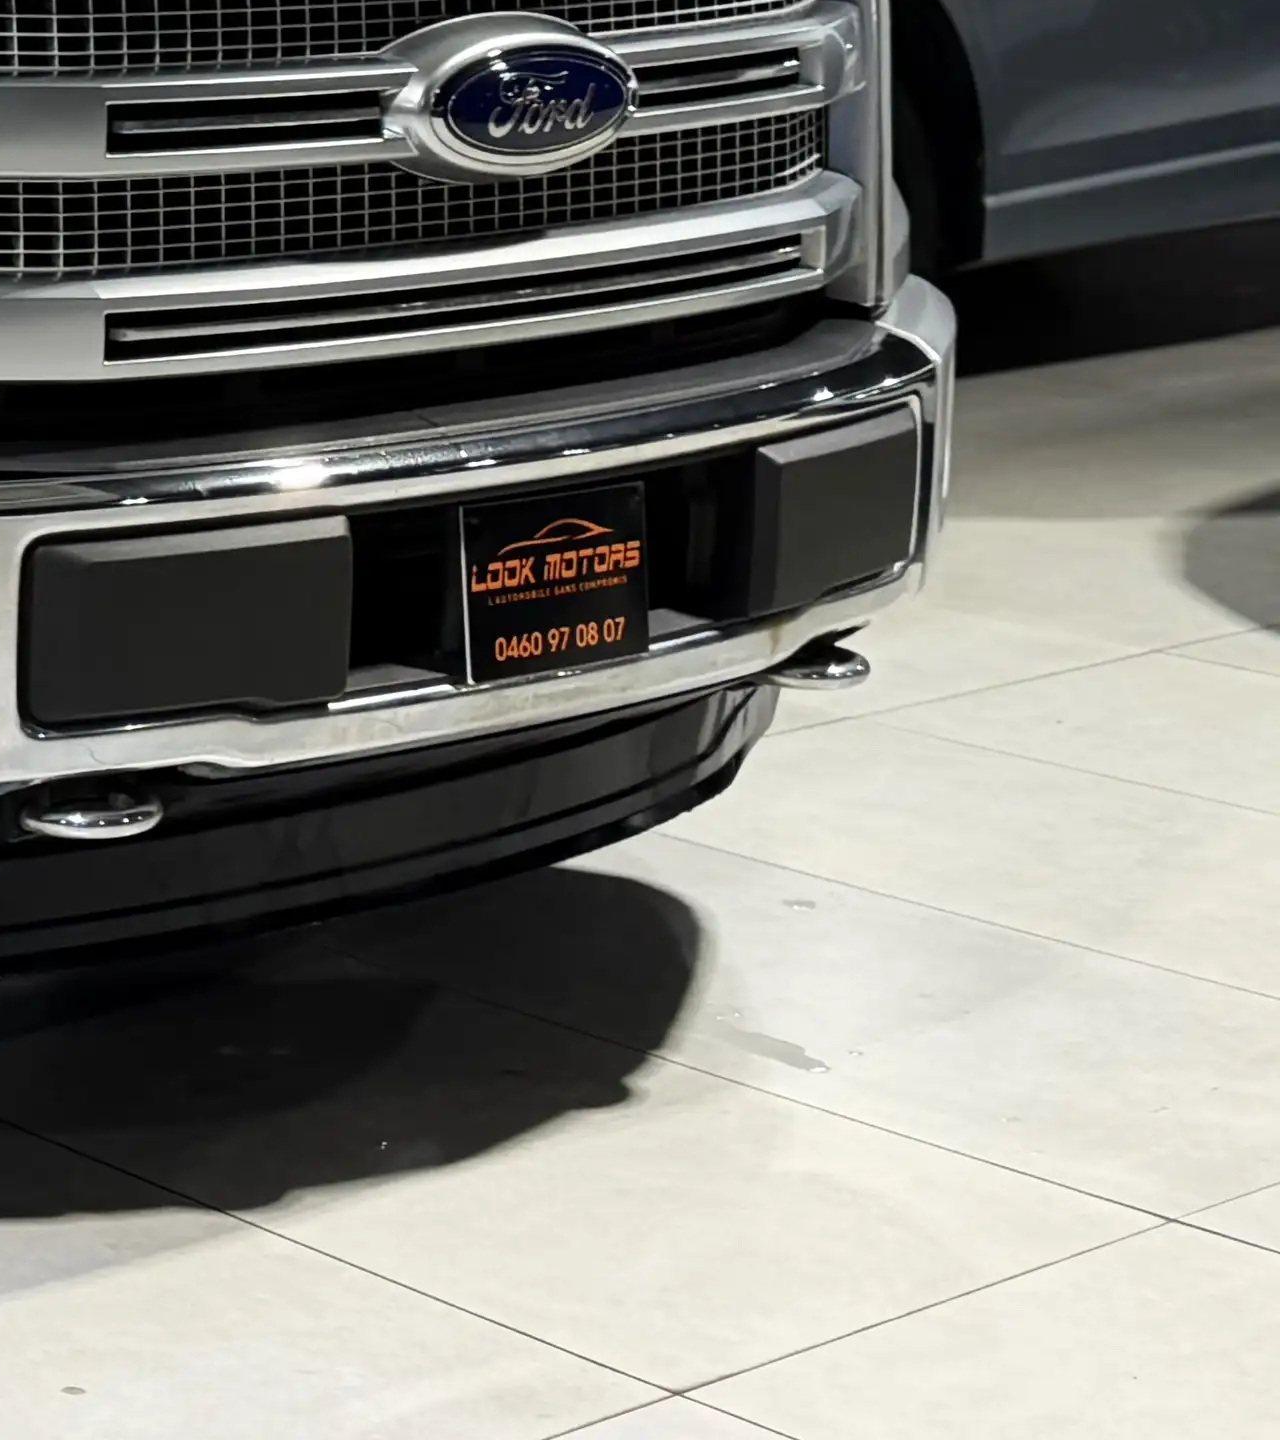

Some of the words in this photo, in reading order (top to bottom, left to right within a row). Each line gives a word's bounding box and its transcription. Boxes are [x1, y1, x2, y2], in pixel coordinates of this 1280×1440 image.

[488, 71, 594, 138] Ford
[471, 557, 536, 592] LOOK
[543, 540, 640, 581] MOTORS
[495, 631, 543, 661] 0460
[547, 626, 571, 652] 97
[576, 621, 599, 648] 08
[603, 616, 626, 643] 07
